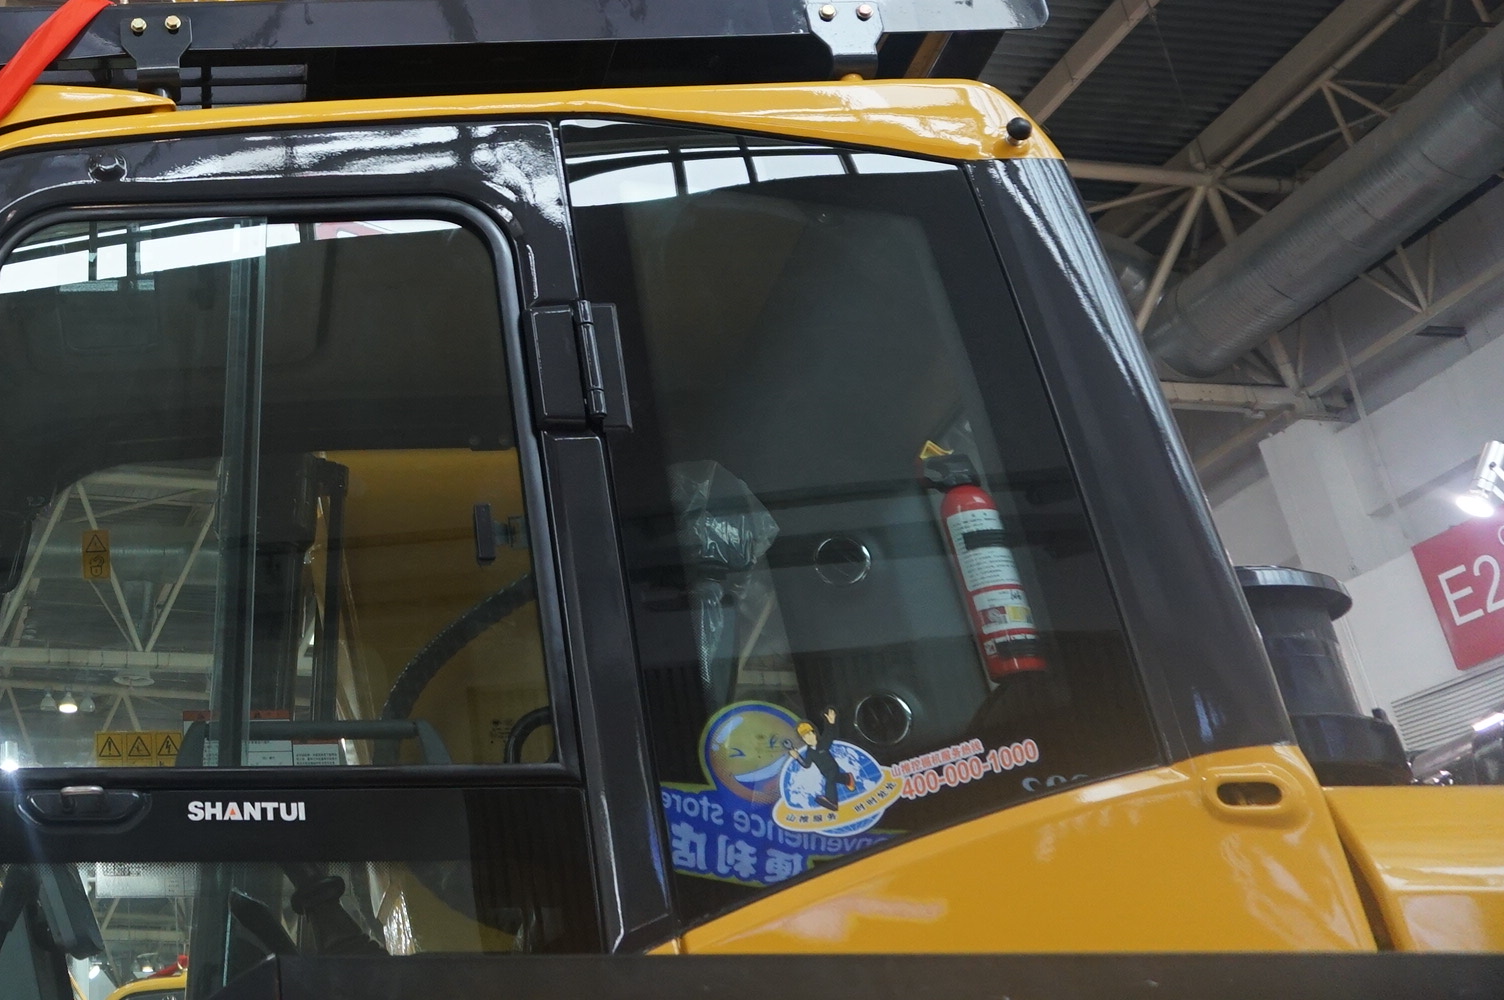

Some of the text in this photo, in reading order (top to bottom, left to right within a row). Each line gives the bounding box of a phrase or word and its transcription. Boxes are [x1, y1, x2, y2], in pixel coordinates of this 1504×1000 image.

[1438, 554, 1504, 626] E2
[902, 739, 1038, 798] 400-000-1000
[187, 801, 306, 821] SHANTUI
